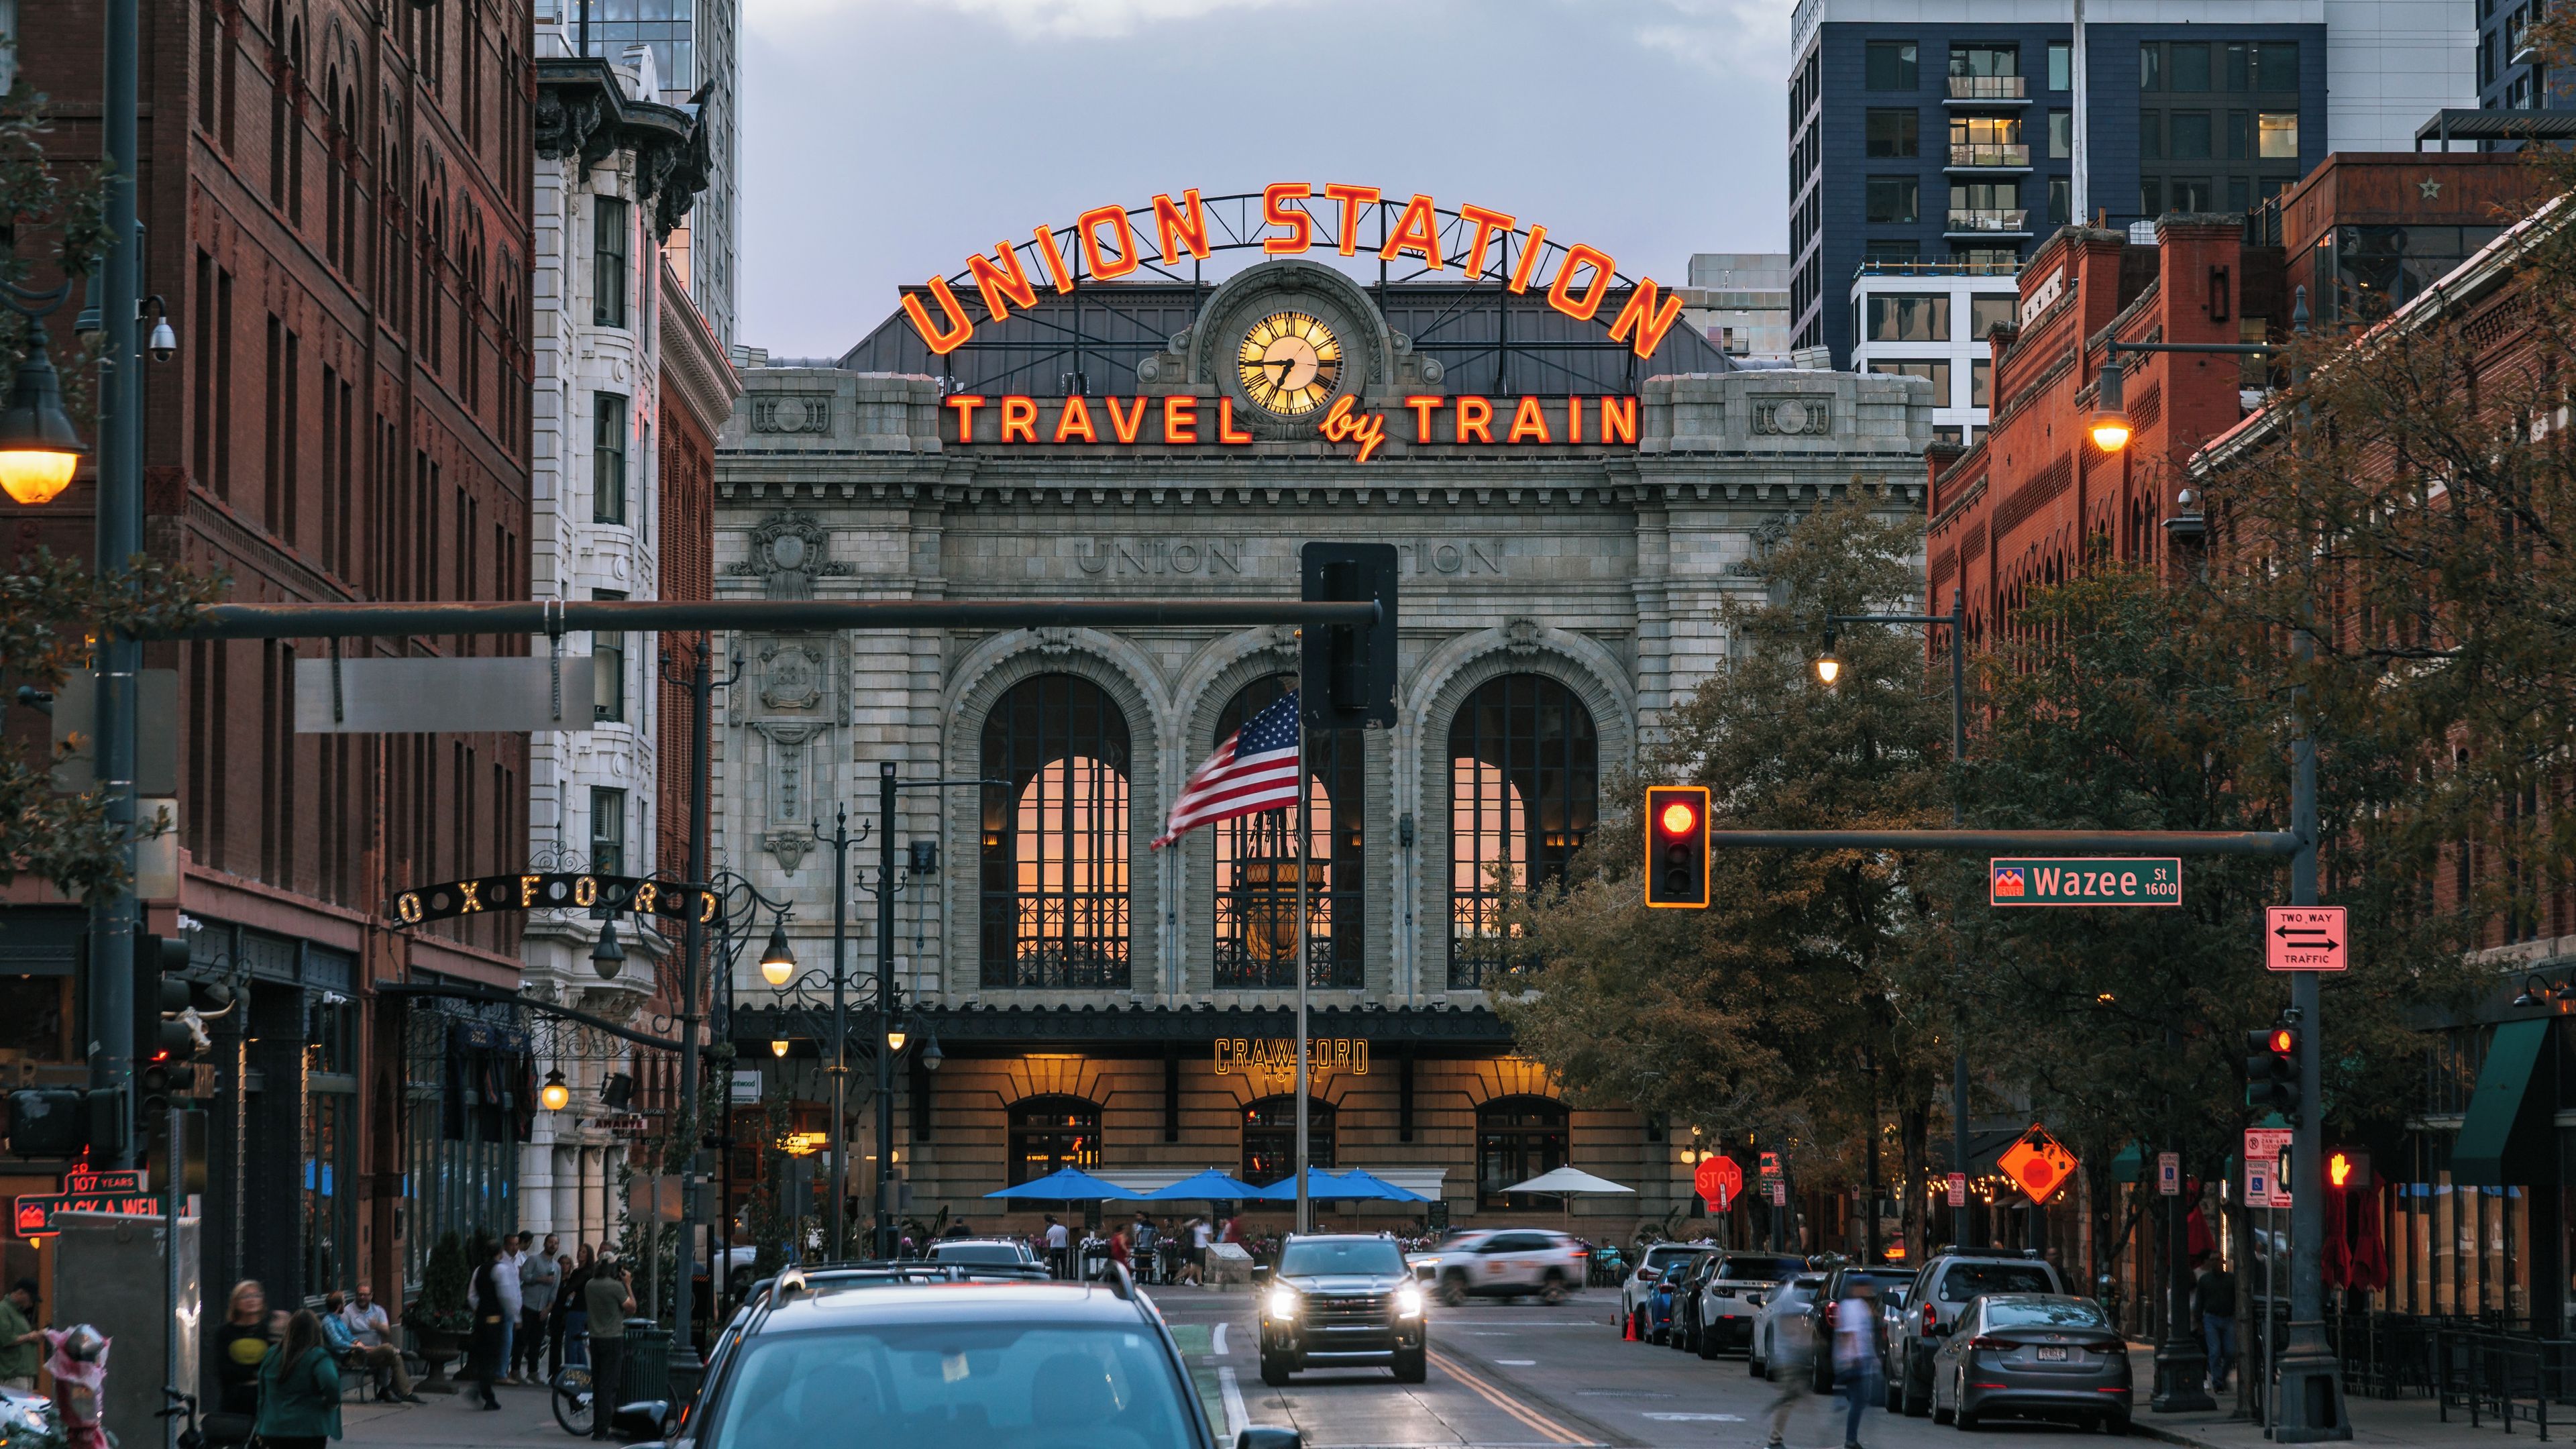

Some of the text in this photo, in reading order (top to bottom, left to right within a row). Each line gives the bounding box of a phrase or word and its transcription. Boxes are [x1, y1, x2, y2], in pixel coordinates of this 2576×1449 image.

[899, 182, 1685, 361] UNION STATION
[945, 393, 1638, 464] TRAVEL by TRAIN
[1075, 542, 1502, 574] UNION TION
[2033, 867, 2167, 896] Wazee St
[2145, 883, 2177, 896] 1600
[398, 875, 716, 924] OXFORD
[1996, 886, 2024, 897] DENVER
[2281, 914, 2332, 922] TWO WAY
[2284, 955, 2329, 963] TRAFFIC
[1263, 1072, 1322, 1083] HOTL
[73, 1177, 133, 1191] 107 YEARS
[1699, 1171, 1738, 1189] STOP
